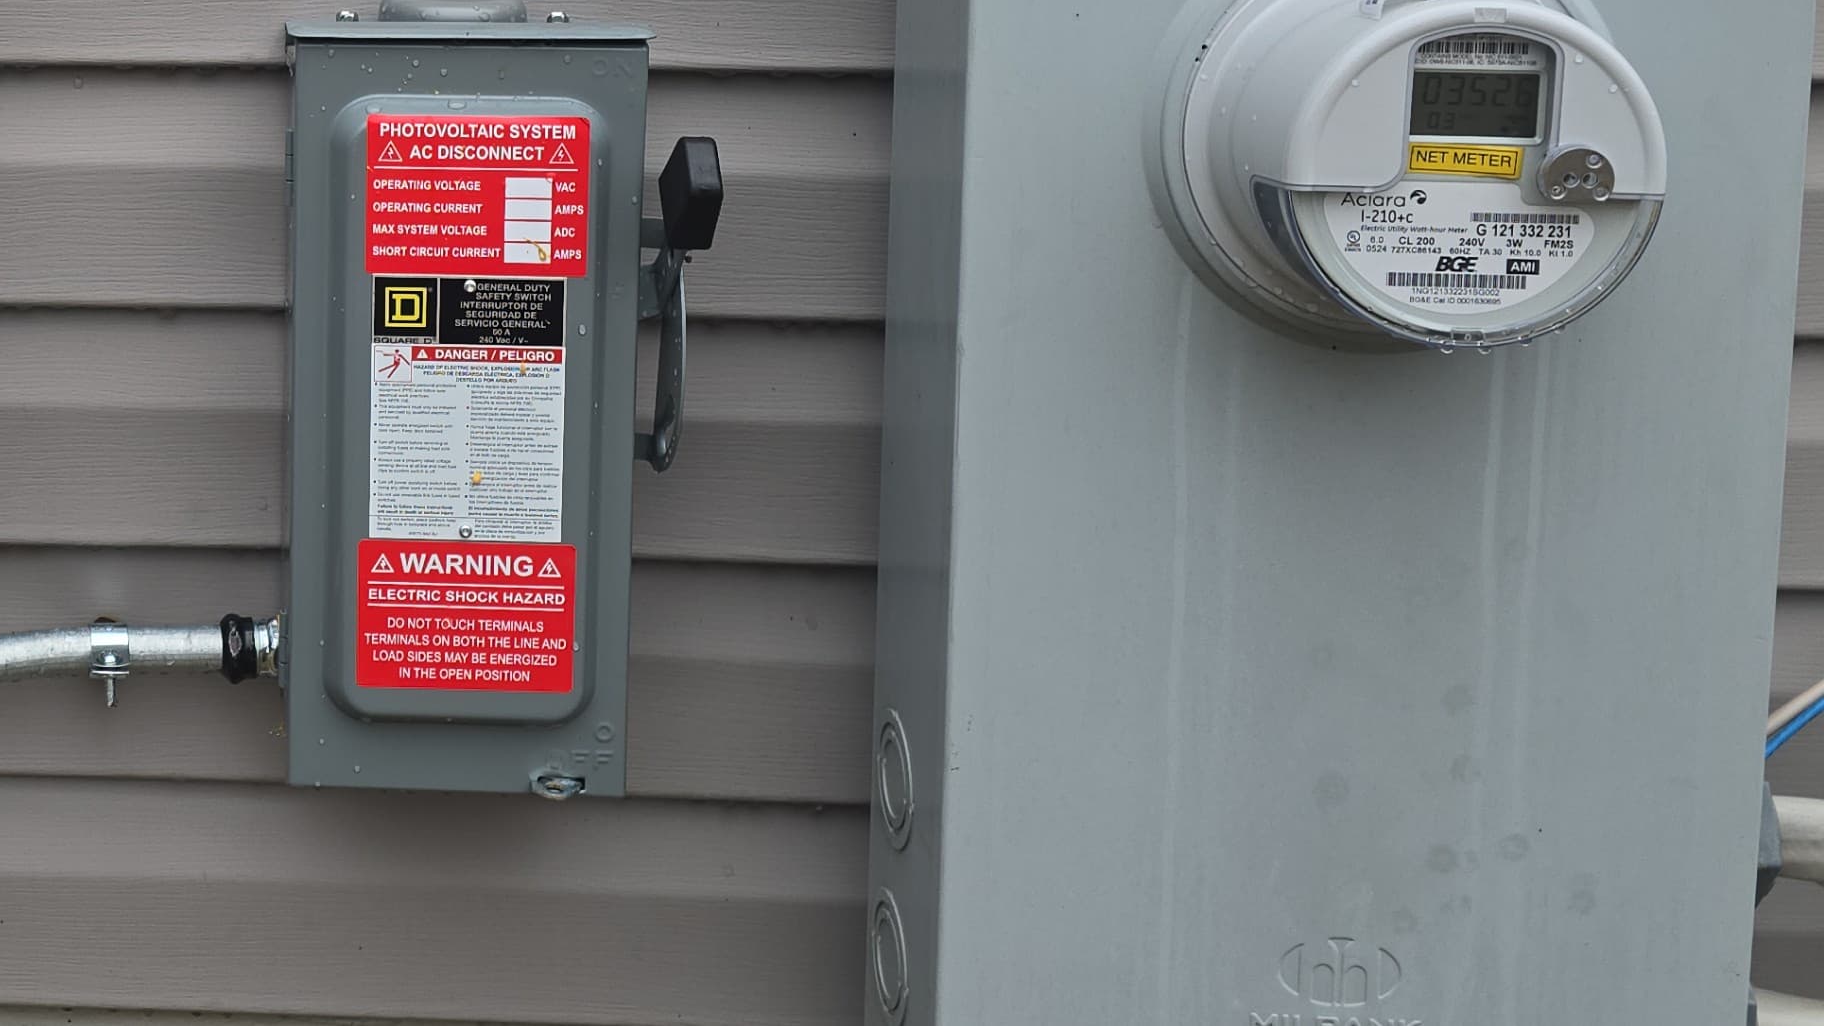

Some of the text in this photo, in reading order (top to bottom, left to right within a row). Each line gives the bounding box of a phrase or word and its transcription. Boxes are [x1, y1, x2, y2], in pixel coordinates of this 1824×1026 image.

[379, 124, 576, 140] PHOTOVOLTAIC SYSTEM
[409, 145, 544, 161] AC DISCONNECT
[1416, 150, 1511, 168] NET METER
[373, 180, 481, 191] OPERATING VOLTAGE
[555, 182, 576, 193] VAC
[1341, 192, 1406, 207] Aclara
[372, 202, 482, 214] OPERATING CURRENT
[554, 204, 584, 216] AMPS
[372, 224, 487, 236] MAX SYSTEM VOLTAGE
[554, 227, 576, 238] ADC
[1476, 224, 1571, 238] G 121 332 231
[1398, 236, 1413, 246] CL
[1416, 236, 1435, 246] 200
[1459, 238, 1485, 247] 240V
[1506, 239, 1523, 248] 3W
[1544, 240, 1574, 249] FM2S
[372, 246, 501, 258] SHORT CIRCUIT CURRENT
[553, 249, 582, 260] AMPS
[1436, 256, 1479, 272] BGE
[1510, 261, 1536, 272] AMI
[477, 283, 551, 292] GENERAL DUTY
[475, 292, 552, 301] SAFETY SWITCH
[460, 302, 528, 310] INTERRUPTOR
[465, 311, 537, 319] SEGURIDAD DE
[454, 319, 546, 328] SERVICIO GENERAL
[503, 328, 511, 336] A
[435, 351, 489, 360] DANGER
[499, 351, 555, 361] PELIGRO
[400, 553, 533, 577] WARNING
[368, 589, 565, 605] ELECTRIC SHOCK HAZARD
[387, 617, 544, 633] DO NOT TOUCH TERMINALS
[364, 633, 567, 650] TERMINALS ON BOTH THE LINE AND
[373, 650, 557, 667] LOAD SIDES MAY BE ENERGIZED
[399, 667, 530, 682] IN THE OPEN POSITION
